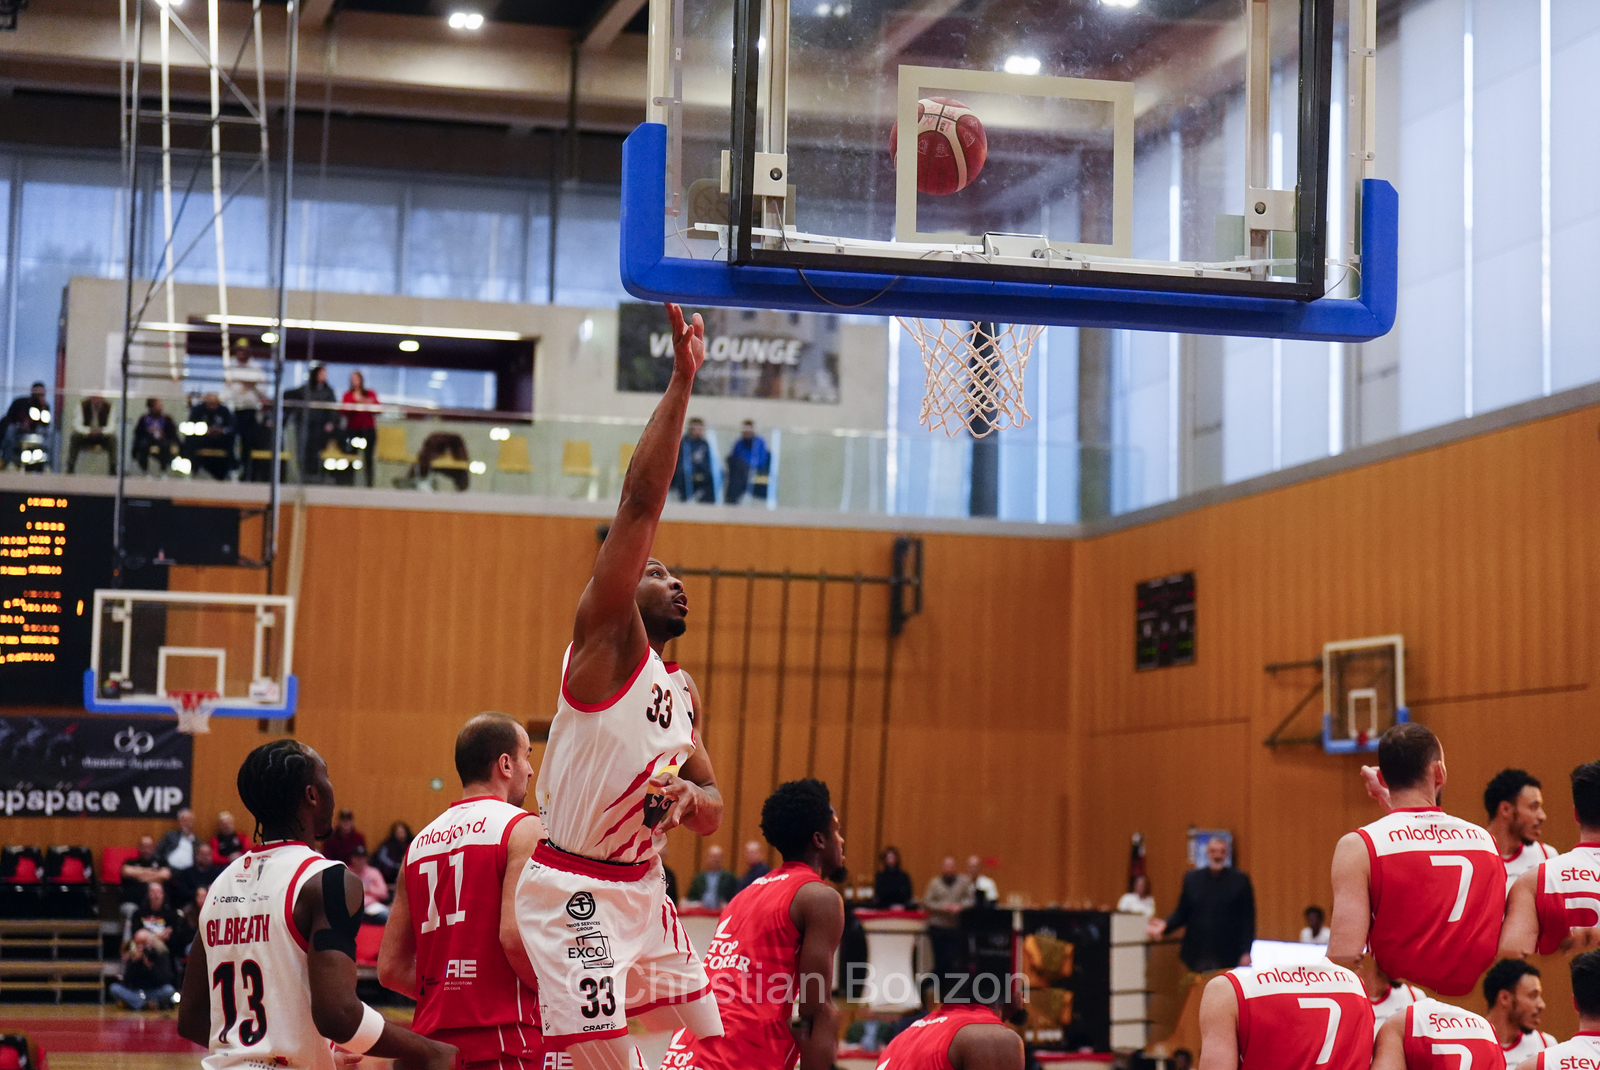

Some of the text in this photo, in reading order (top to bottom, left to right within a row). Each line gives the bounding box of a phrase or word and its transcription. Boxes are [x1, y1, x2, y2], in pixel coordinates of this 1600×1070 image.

[646, 683, 673, 729] 33
[133, 786, 183, 813] VIP
[1388, 824, 1464, 843] mladjan
[419, 851, 466, 934] 11
[1429, 855, 1474, 922] 7
[568, 946, 605, 959] EXCO
[708, 940, 738, 956] TOP
[1256, 966, 1332, 986] mladjan
[213, 959, 267, 1047] 13
[579, 975, 616, 1019] 33
[583, 1023, 610, 1031] CRAFT
[1297, 998, 1342, 1065] 7
[663, 1051, 693, 1067] TOP
